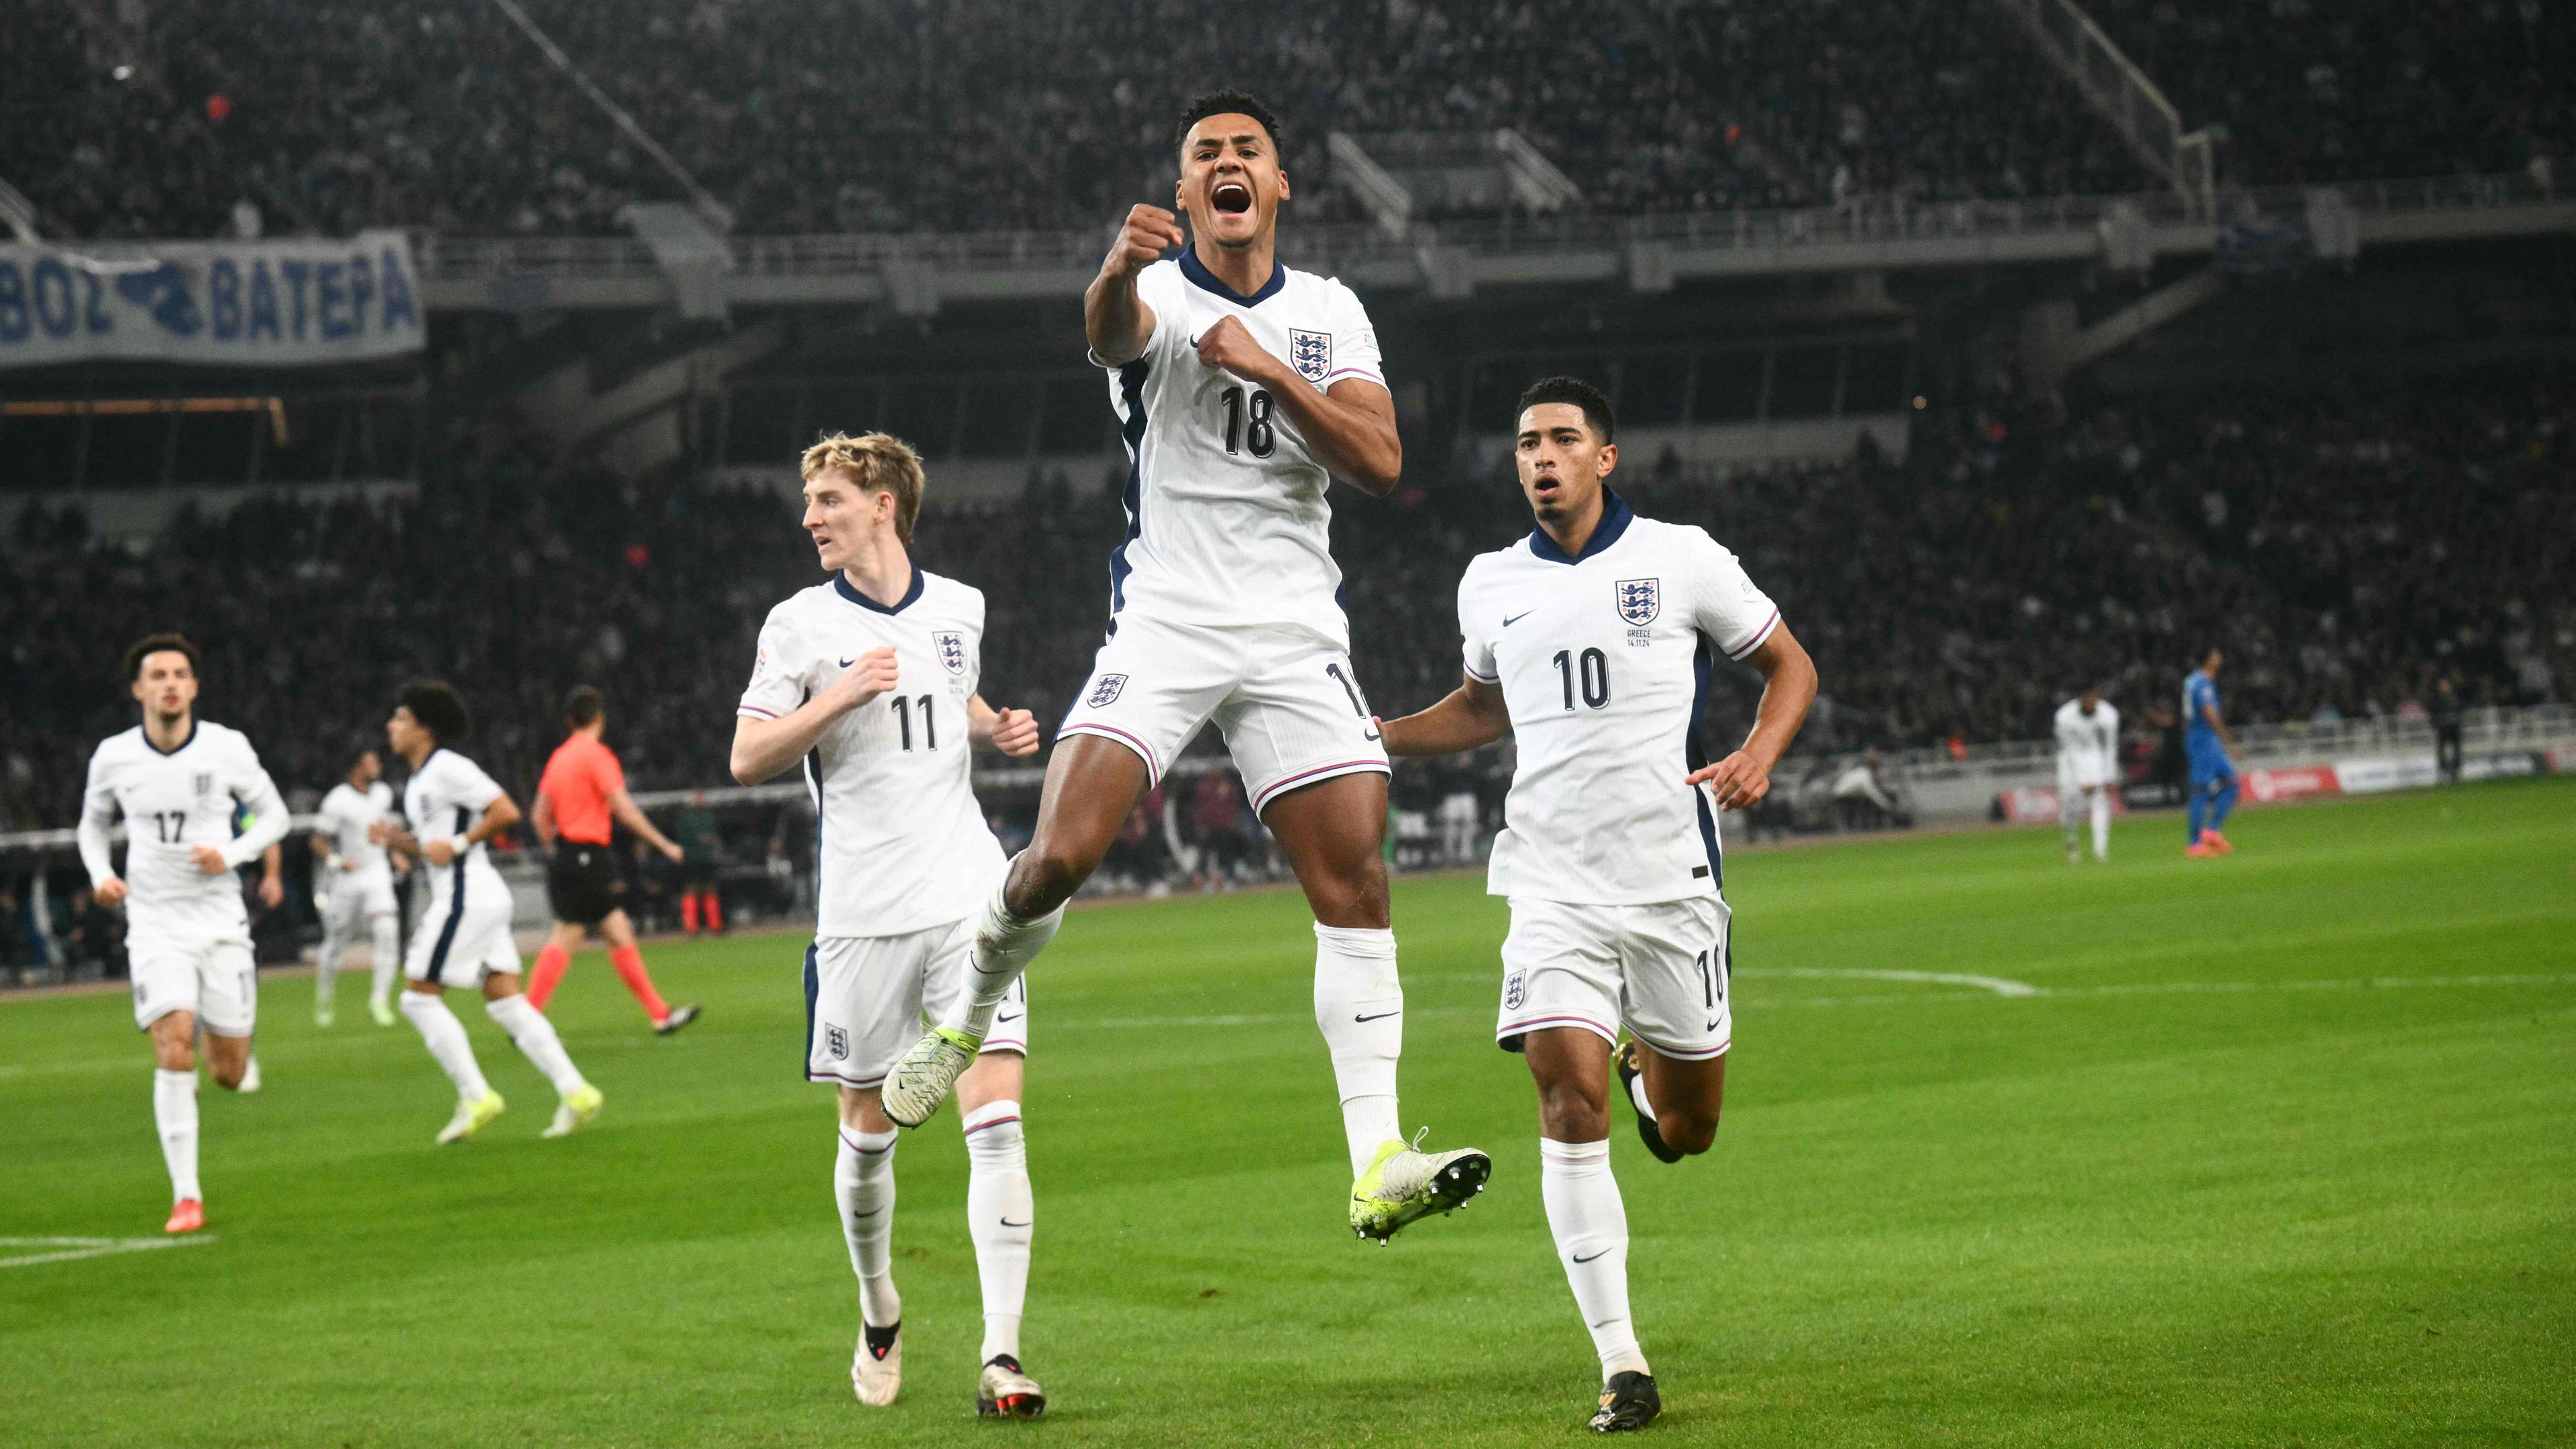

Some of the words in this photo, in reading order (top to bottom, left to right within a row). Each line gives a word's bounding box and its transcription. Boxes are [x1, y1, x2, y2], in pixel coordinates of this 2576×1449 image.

[1221, 386, 1277, 459] 18
[1627, 629, 1652, 638] GREECE
[1627, 639, 1650, 647] 14.11.24
[1326, 663, 1372, 719] 1
[1553, 647, 1611, 712] 10
[891, 694, 938, 753] 11
[154, 810, 186, 844] 17
[1697, 943, 1723, 1010] 10
